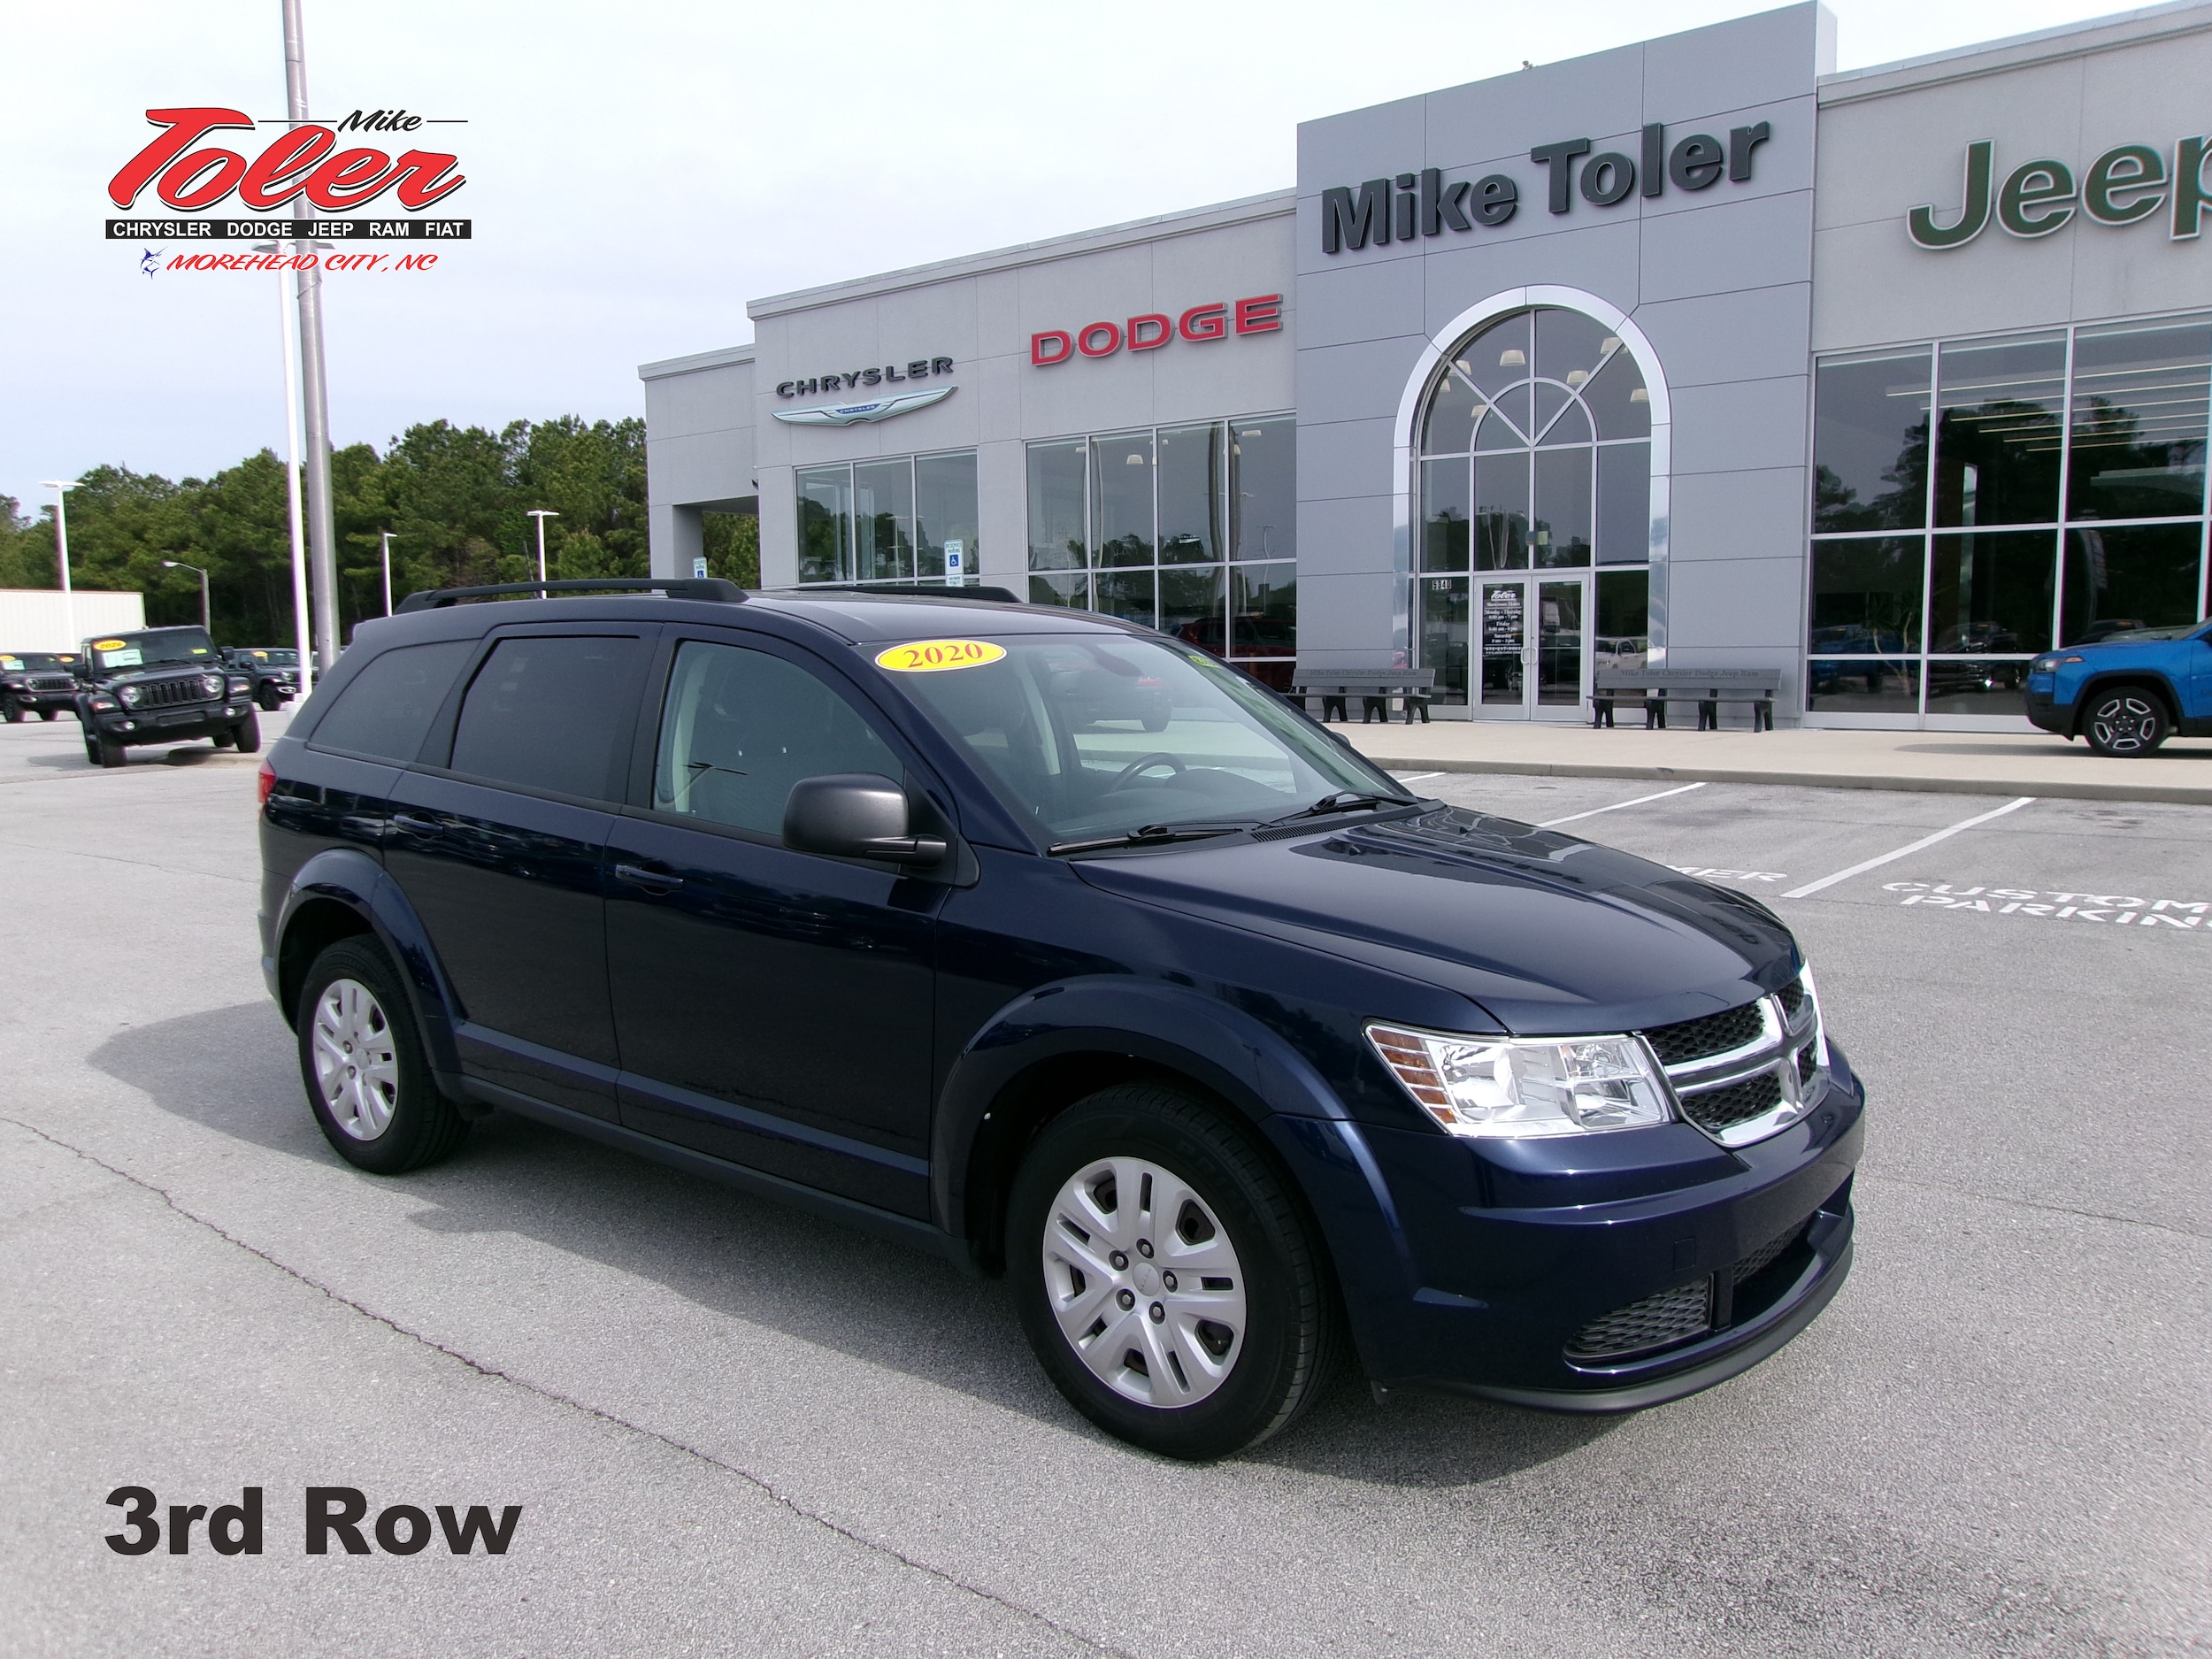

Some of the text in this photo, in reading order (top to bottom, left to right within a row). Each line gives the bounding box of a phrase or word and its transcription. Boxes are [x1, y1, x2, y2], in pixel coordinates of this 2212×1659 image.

[1321, 121, 1770, 254] Mike Toler
[1030, 293, 1284, 367] DODGE
[776, 357, 955, 398] CHRYSLER
[839, 404, 876, 414] CHRYSLER
[1491, 590, 1517, 599] Toler
[903, 643, 983, 668] 2020
[1694, 670, 1719, 679] Dodge
[1719, 670, 1739, 680] Jeep
[1901, 895, 2212, 929] PARKIN
